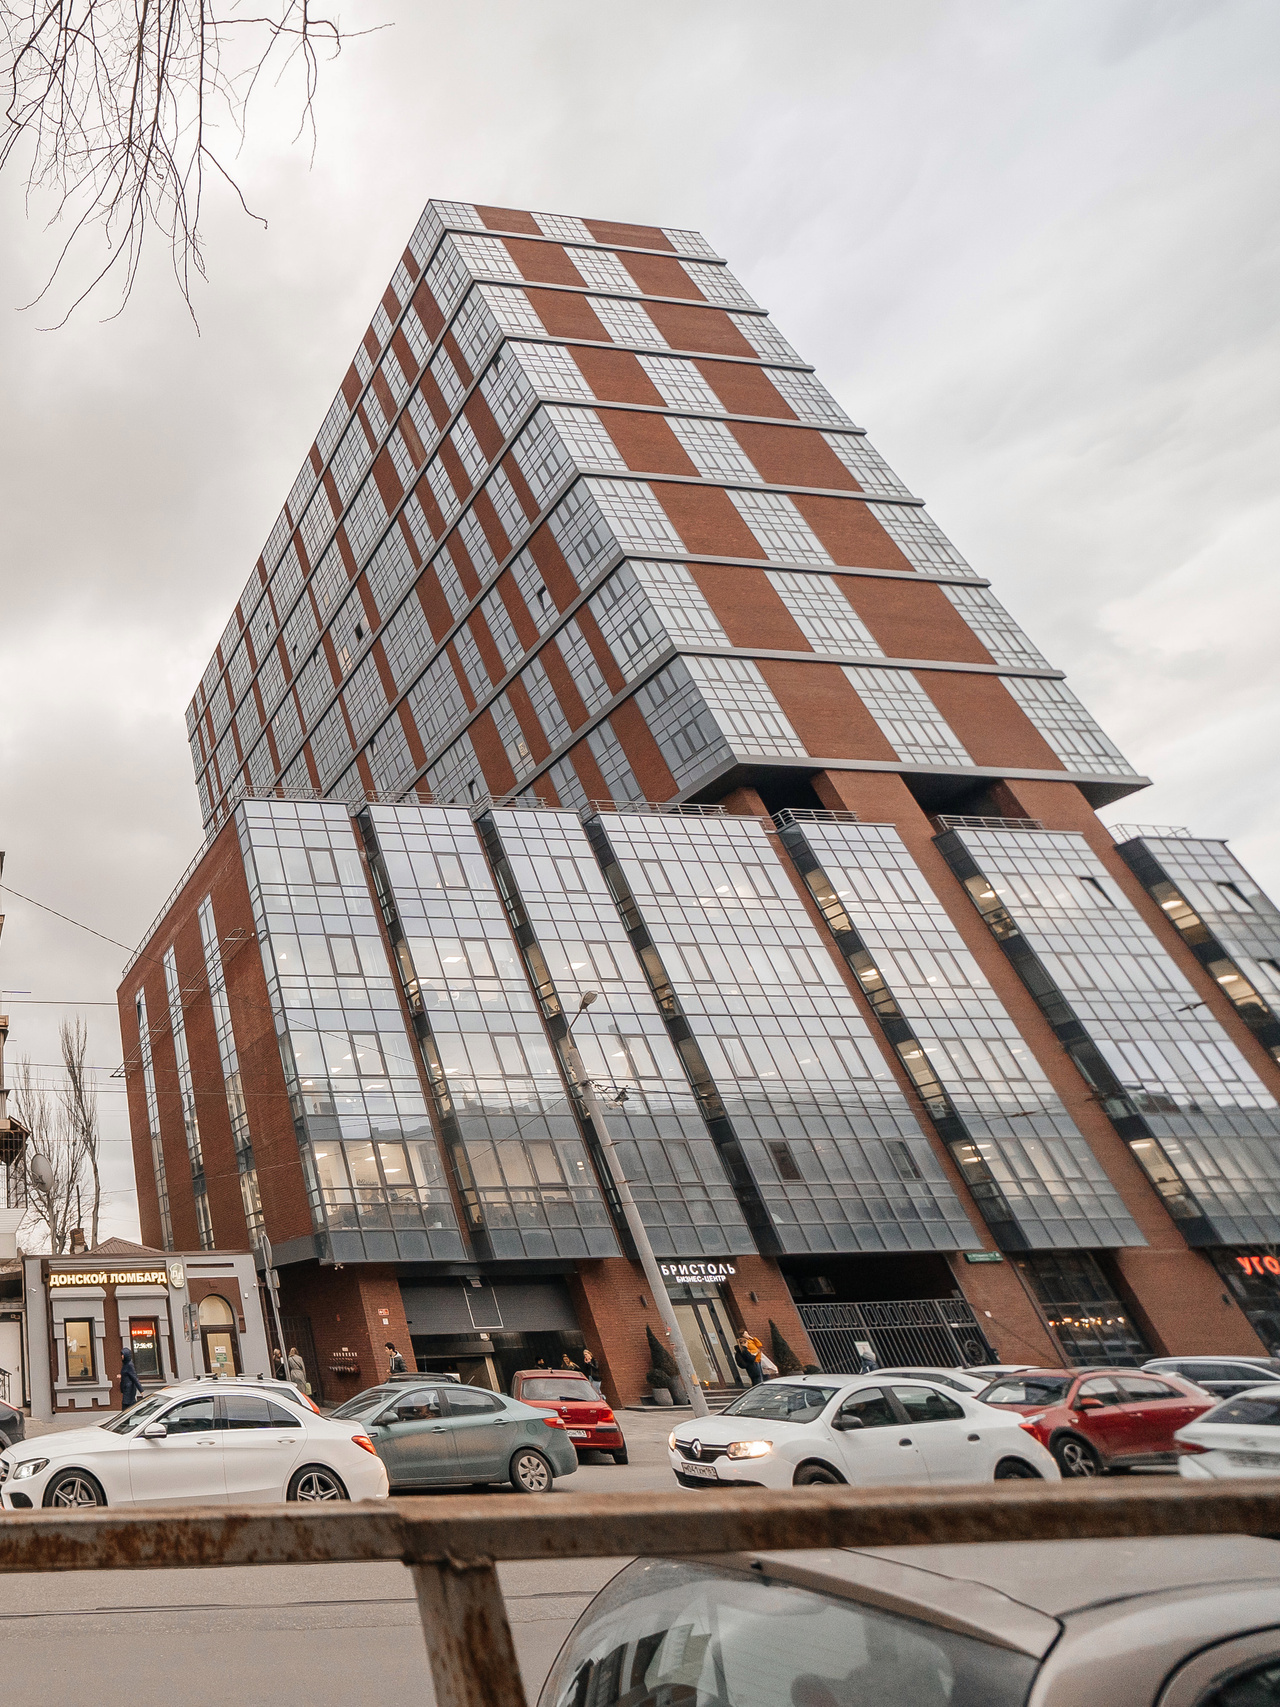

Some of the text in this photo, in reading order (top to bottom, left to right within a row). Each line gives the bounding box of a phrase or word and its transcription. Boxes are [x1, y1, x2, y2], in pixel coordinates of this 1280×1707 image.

[660, 1263, 737, 1276] БРИСТОЛЬ
[49, 1271, 168, 1287] ДОНСКОЙ ЛОМБАРД
[675, 1275, 727, 1284] БИЗНЕС-ЦЕНТР
